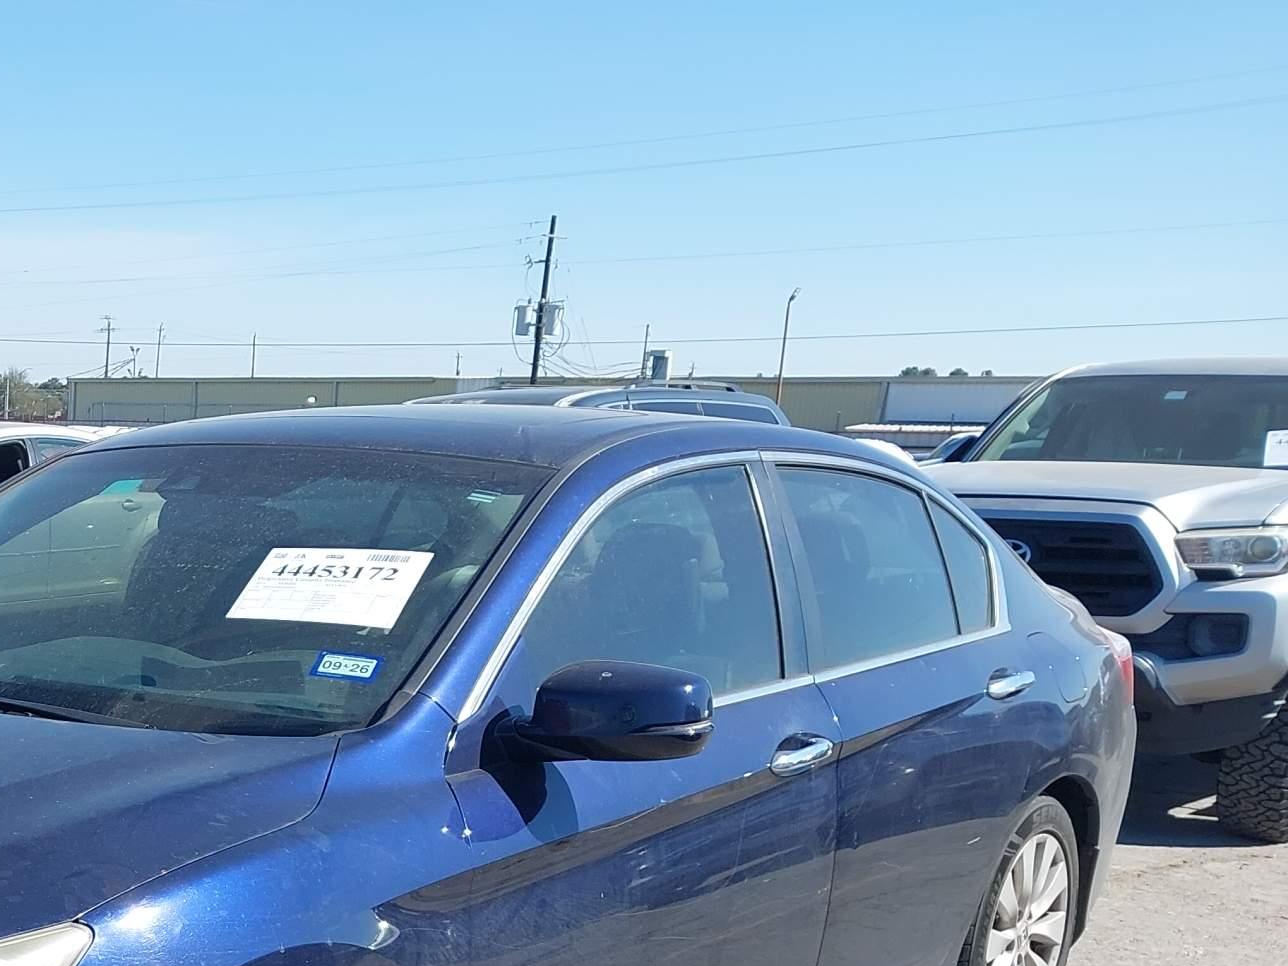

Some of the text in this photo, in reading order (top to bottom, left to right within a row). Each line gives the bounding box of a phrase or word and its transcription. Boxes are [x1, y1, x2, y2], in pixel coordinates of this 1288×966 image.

[271, 564, 400, 581] 44453172
[322, 660, 371, 674] 09 26
